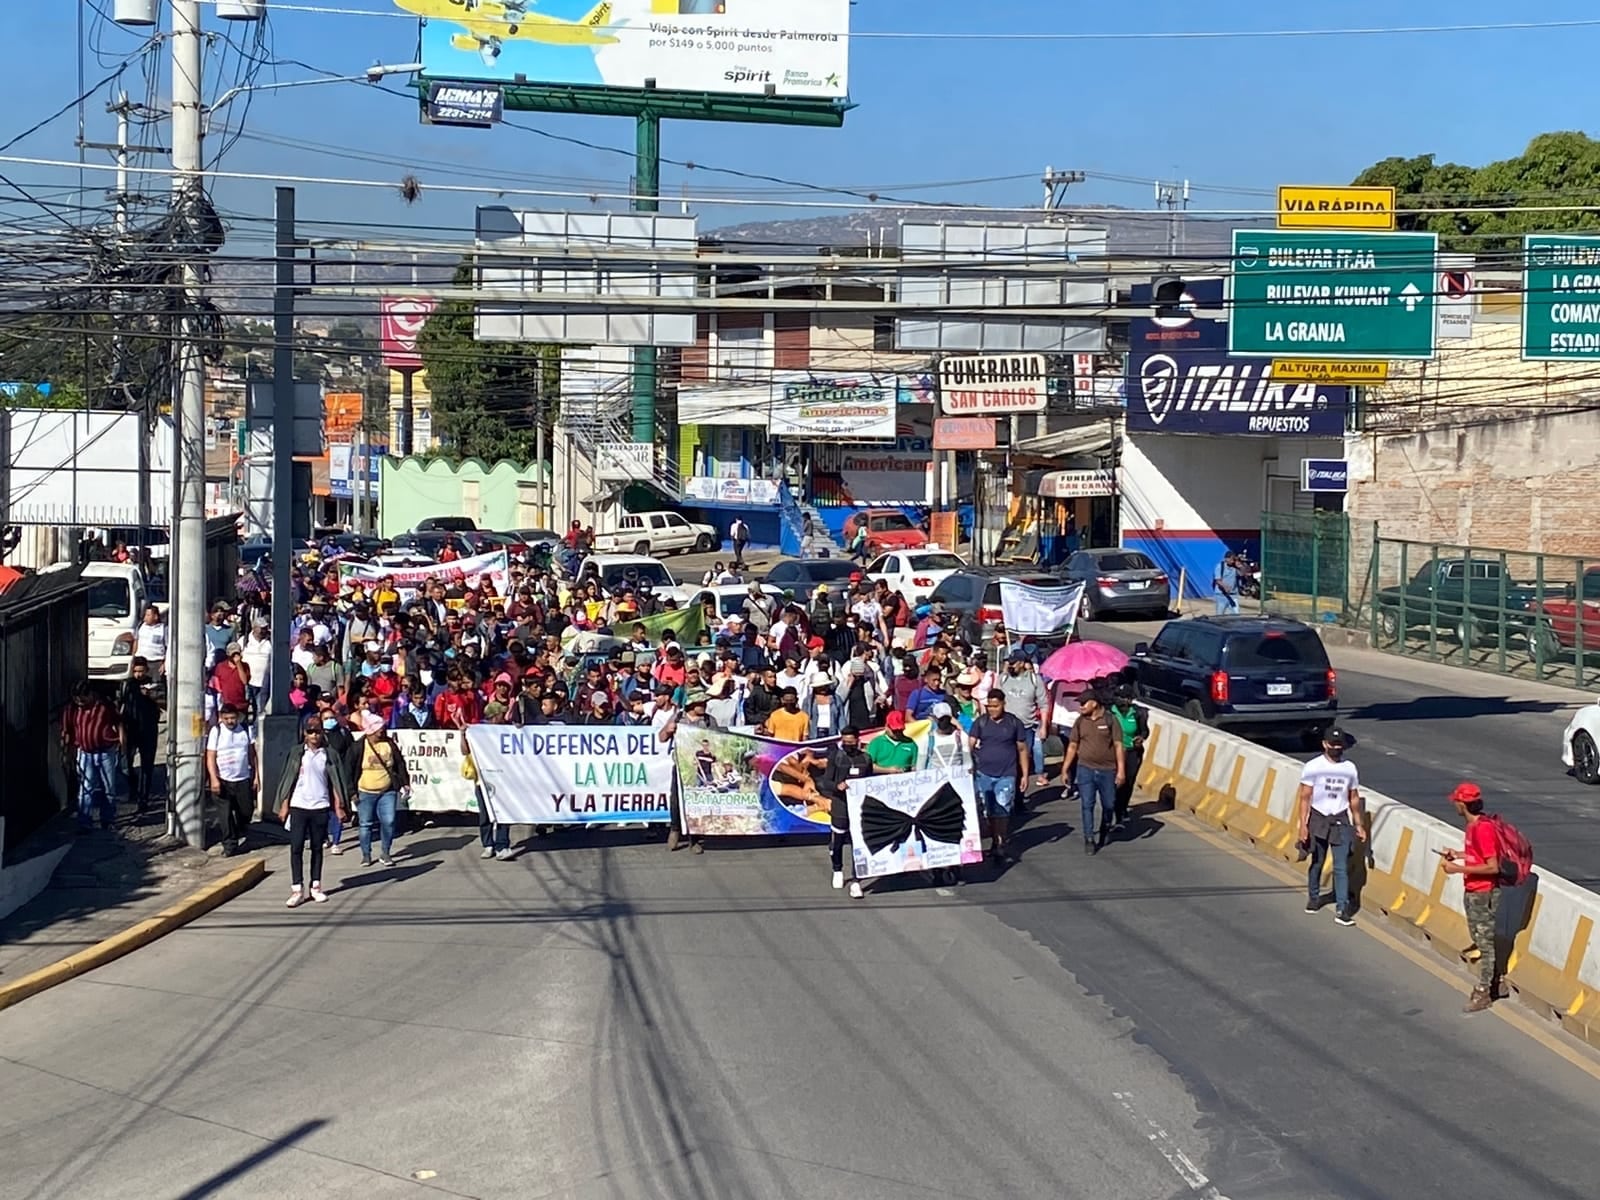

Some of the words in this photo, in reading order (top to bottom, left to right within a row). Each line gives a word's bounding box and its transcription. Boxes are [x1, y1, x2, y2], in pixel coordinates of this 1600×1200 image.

[589, 3, 611, 26] spirit
[681, 26, 703, 35] con
[706, 25, 738, 38] Spirit
[742, 28, 777, 38] desde
[780, 30, 838, 42] Palmerola
[649, 39, 667, 48] por
[669, 38, 694, 48] $149
[738, 42, 773, 52] puntos
[724, 69, 773, 83] spirit
[785, 69, 809, 78] Banco
[1268, 248, 1333, 268] BULEVAR
[1553, 274, 1570, 294] LA
[1267, 285, 1331, 305] BULEVAR
[1334, 286, 1391, 306] KUWAIT
[1551, 303, 1600, 323] COMAY
[1265, 321, 1284, 341] LA
[1287, 321, 1346, 342] GRANJA
[943, 357, 1041, 385] FUNERARIA
[1279, 363, 1328, 373] ALTURA
[785, 383, 885, 402] Pinturas
[950, 389, 978, 409] SAN
[983, 386, 1037, 407] CARLOS
[1175, 365, 1317, 411] ITALIKA
[1249, 416, 1310, 432] REPUESTOS
[500, 733, 524, 754] EN
[533, 733, 619, 756] DEFENSA
[627, 733, 659, 755] DEL
[575, 762, 598, 785] LA
[604, 762, 648, 786] VIDA
[551, 793, 566, 812] Y
[570, 794, 596, 812] LA
[602, 793, 669, 812] TIERRA
[684, 792, 759, 805] PLATAFORMA
